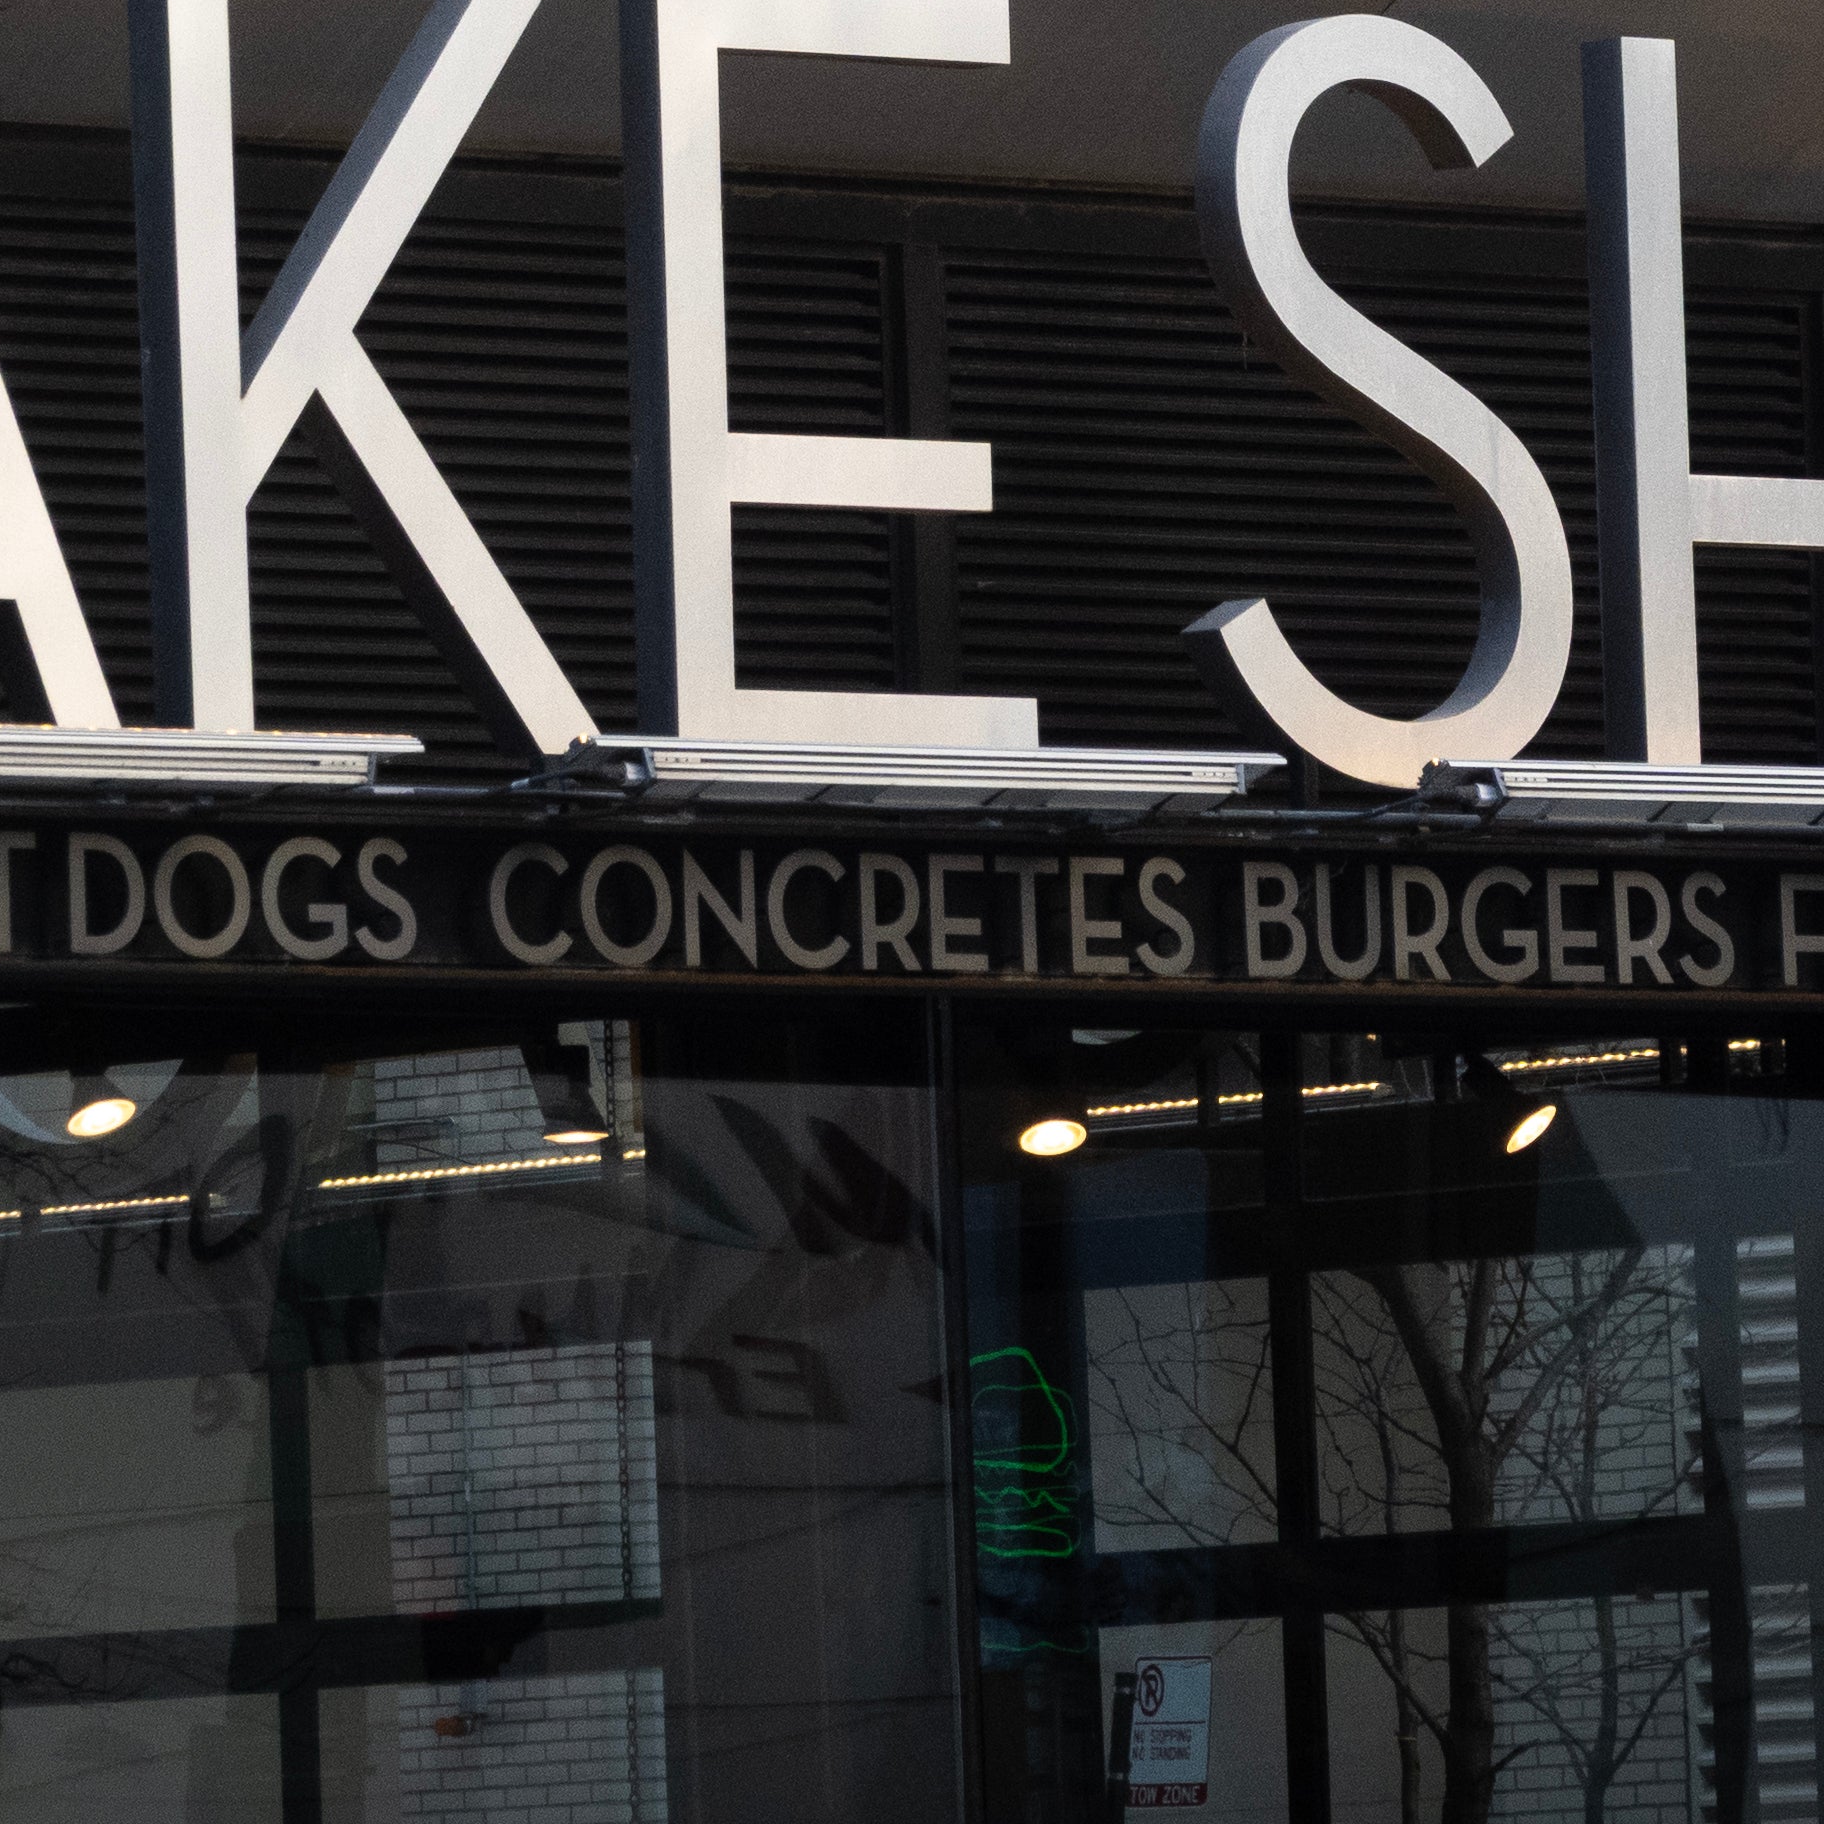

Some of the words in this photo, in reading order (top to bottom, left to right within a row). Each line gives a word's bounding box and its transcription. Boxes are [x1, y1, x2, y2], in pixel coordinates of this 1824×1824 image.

[67, 831, 419, 961] DOGS
[488, 841, 1197, 977] CONCRETES
[1241, 860, 1736, 989] BURGERS
[1129, 1786, 1157, 1806] TOW
[1160, 1785, 1201, 1805] ZONE
